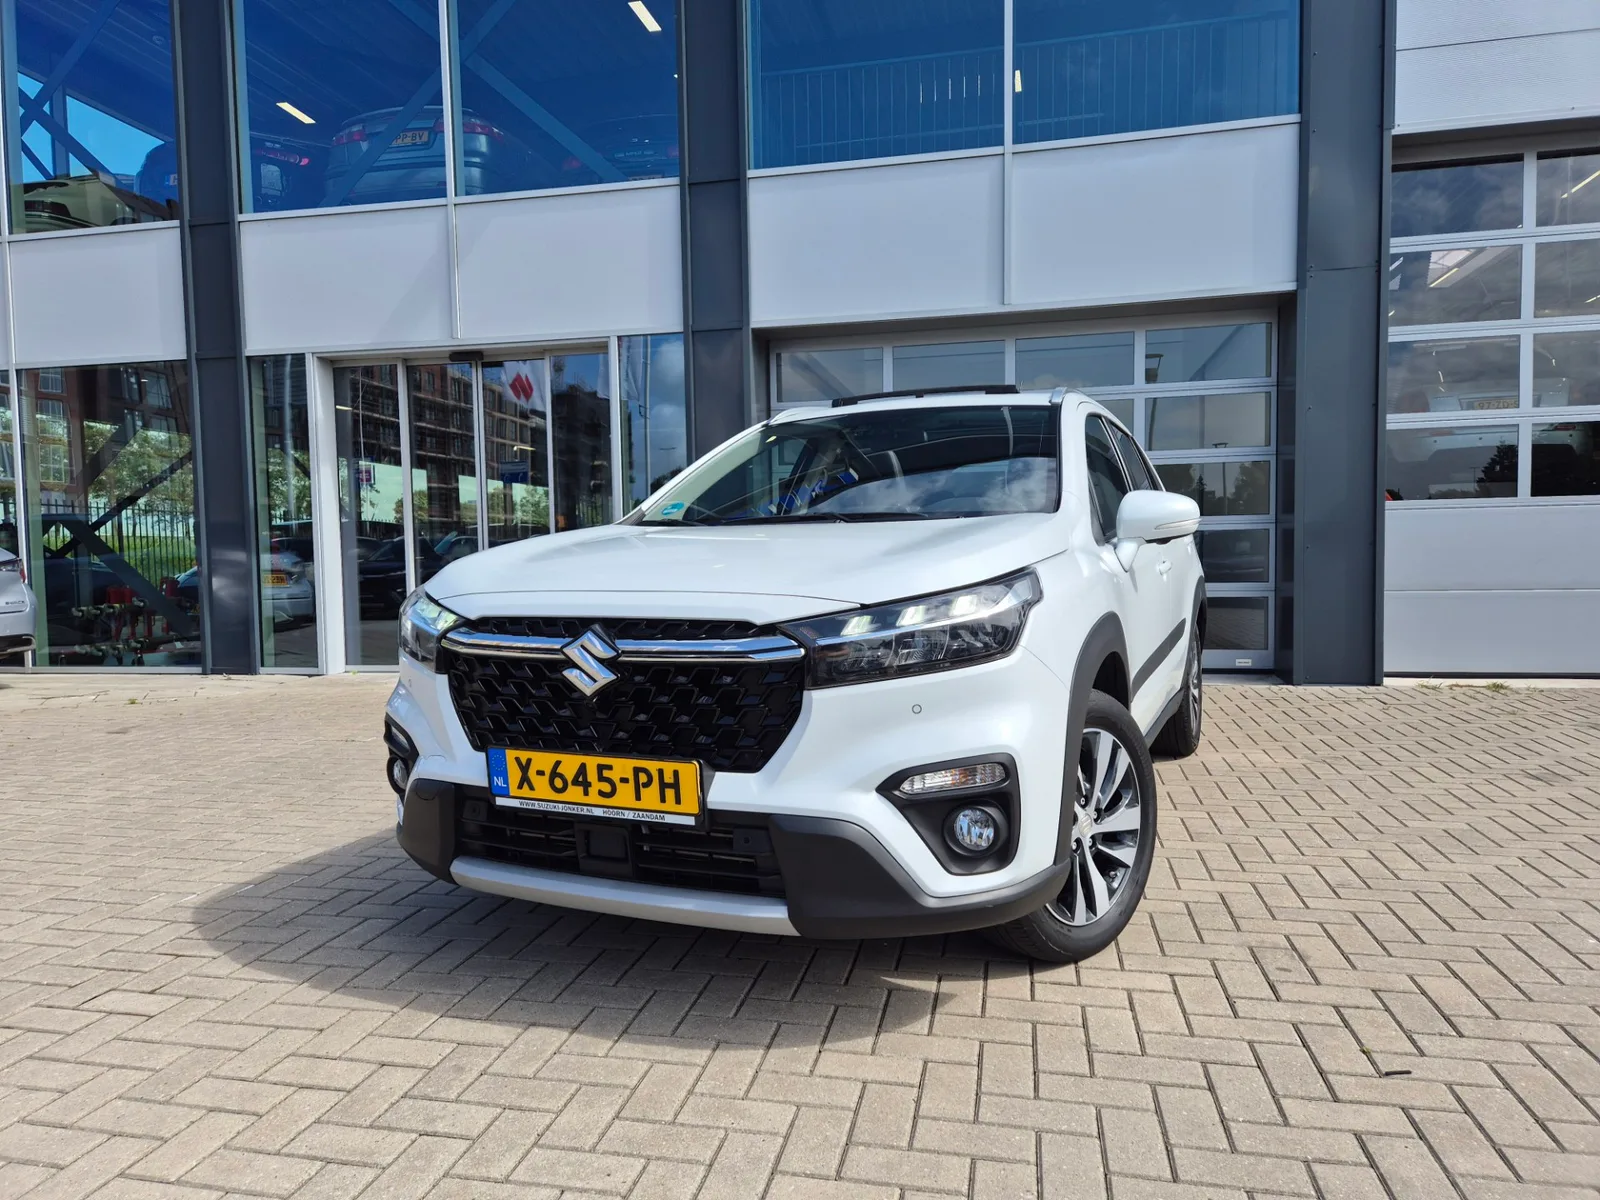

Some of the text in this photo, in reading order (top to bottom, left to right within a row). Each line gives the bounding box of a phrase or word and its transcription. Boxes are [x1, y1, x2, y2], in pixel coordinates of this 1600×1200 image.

[493, 756, 682, 805] NL X-645-PH
[602, 809, 625, 818] HOORN
[632, 811, 666, 821] ZAANDAM
